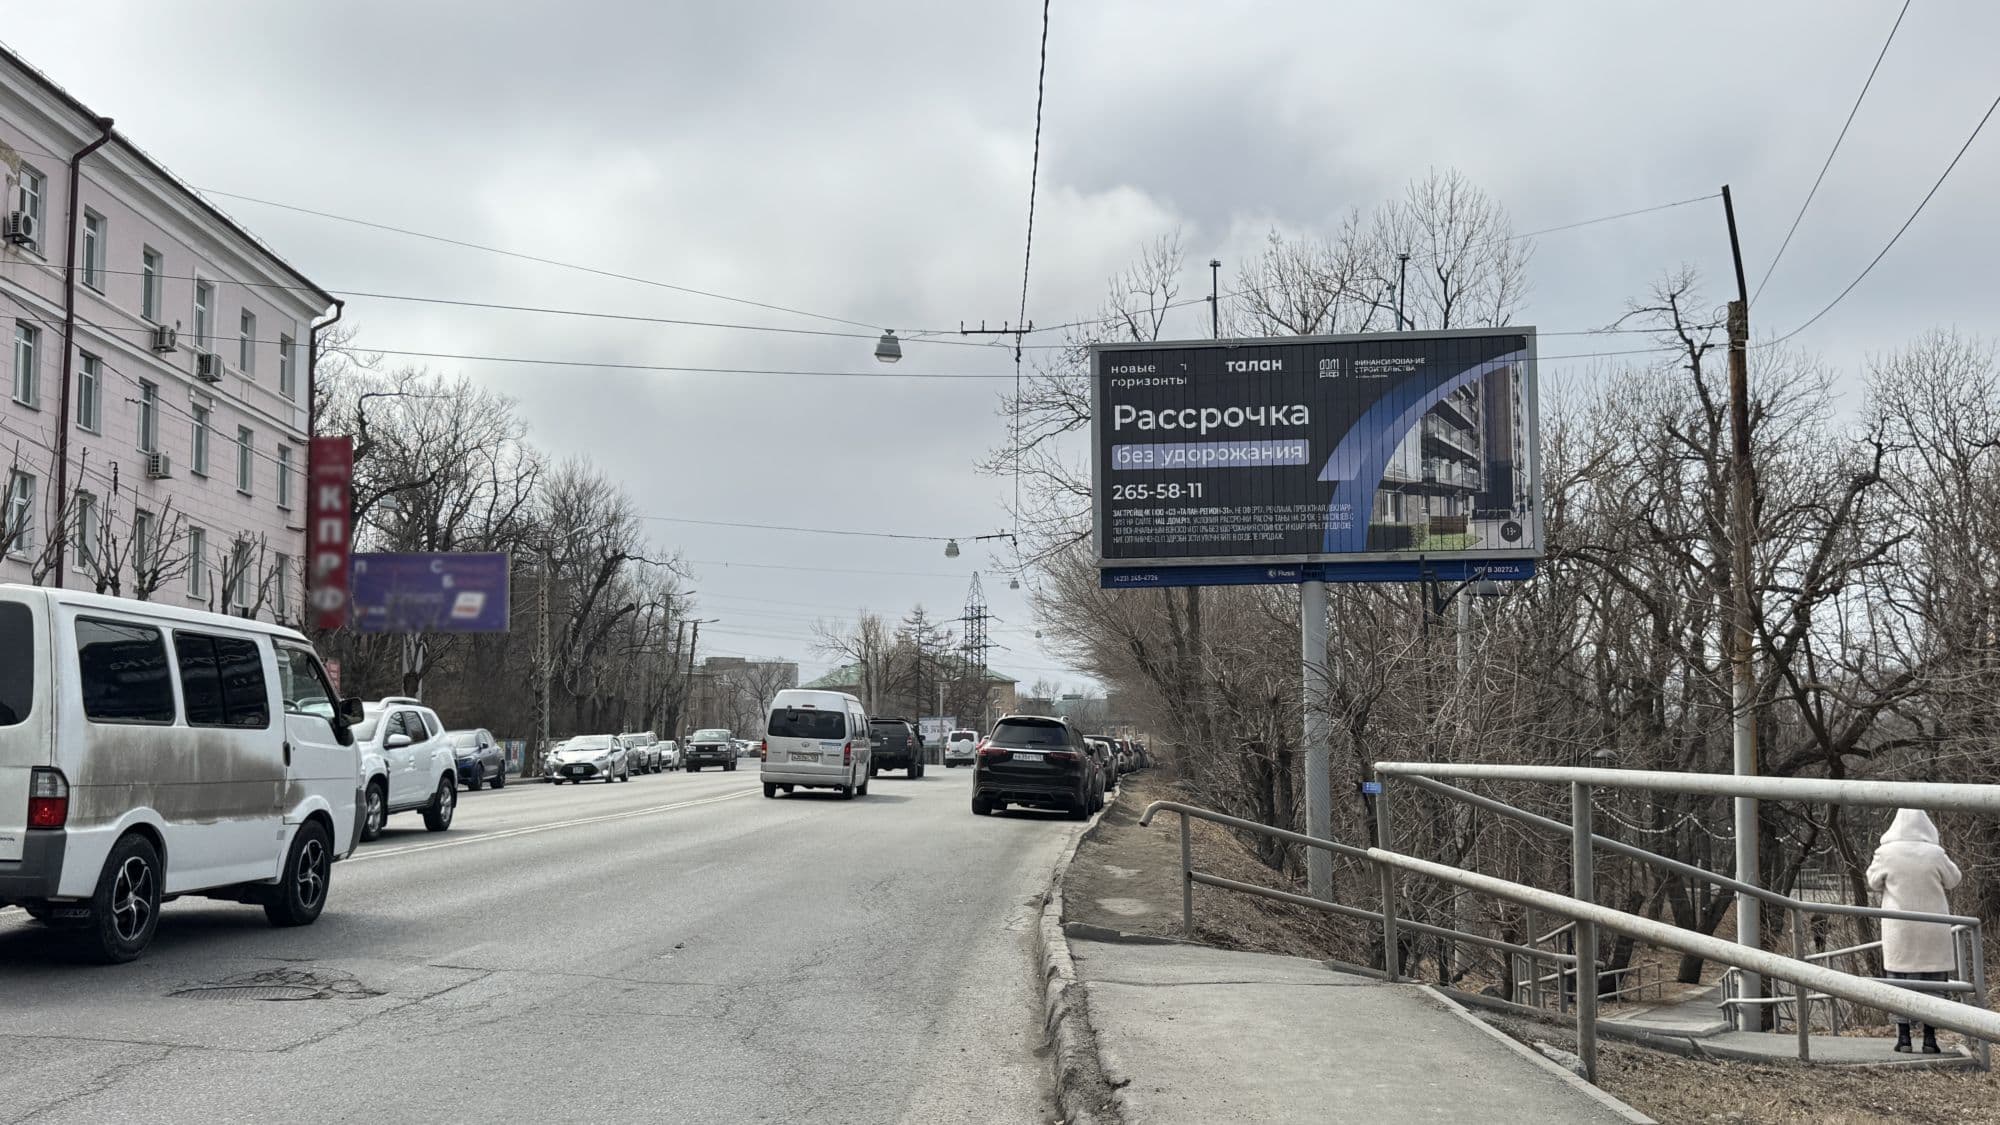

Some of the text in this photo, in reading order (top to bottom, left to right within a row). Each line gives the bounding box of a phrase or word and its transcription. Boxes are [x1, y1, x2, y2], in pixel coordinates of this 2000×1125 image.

[1111, 363, 1156, 374] новые
[1225, 359, 1283, 373] талан
[1111, 376, 1187, 389] горизонты
[1114, 403, 1310, 436] Рассрочка
[1117, 445, 1303, 467] без удорожания
[1112, 482, 1202, 500] 265-58-11
